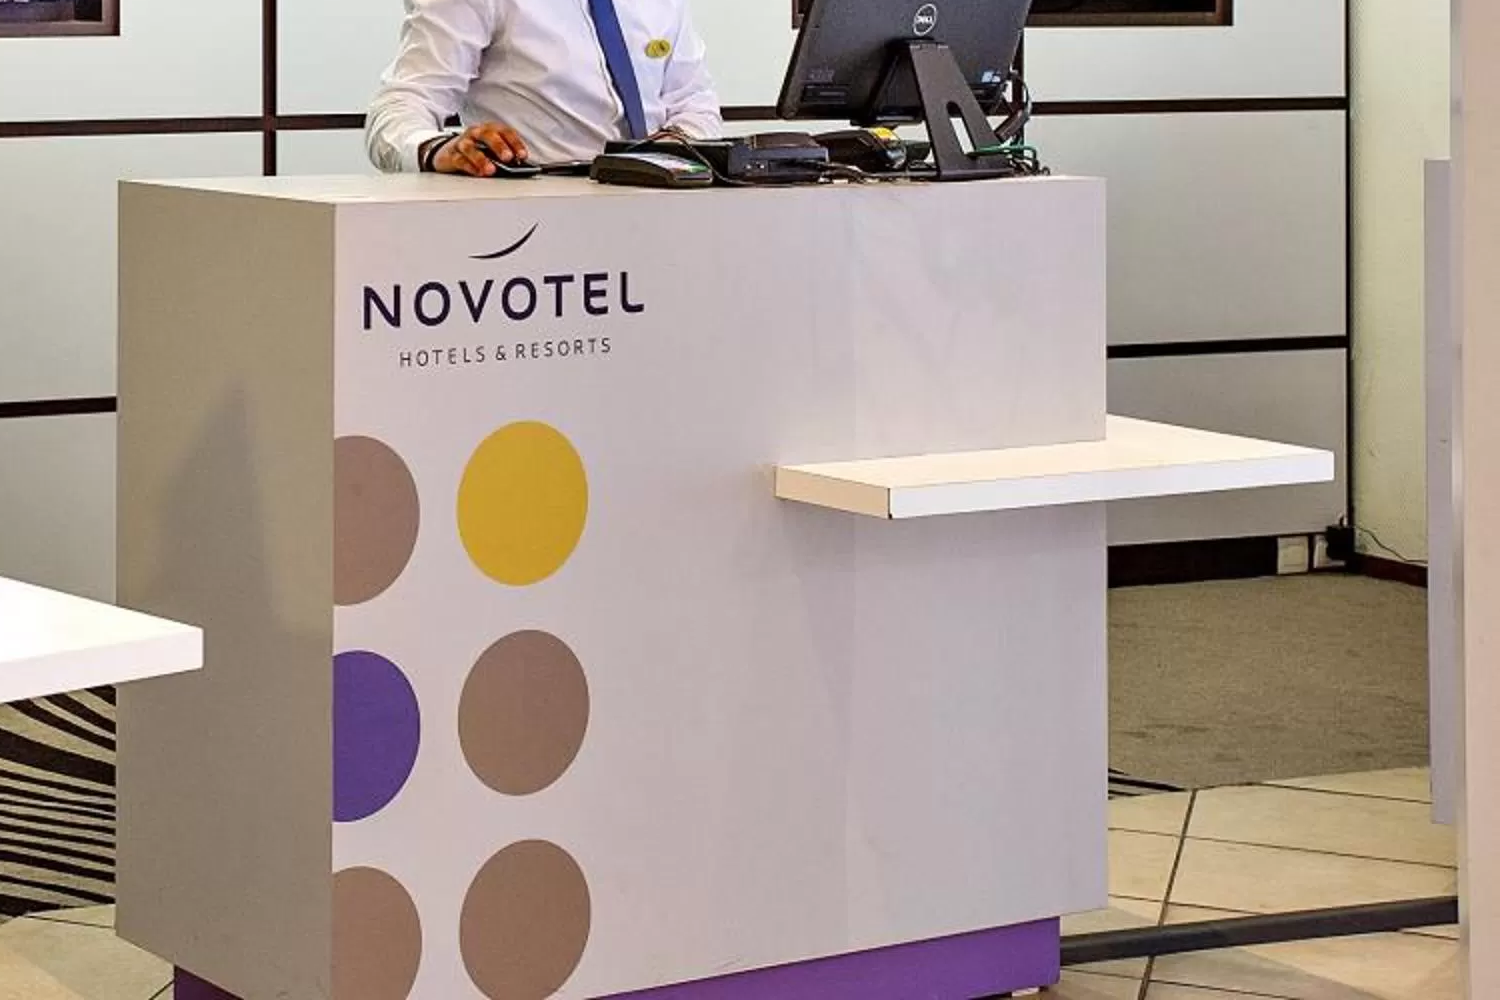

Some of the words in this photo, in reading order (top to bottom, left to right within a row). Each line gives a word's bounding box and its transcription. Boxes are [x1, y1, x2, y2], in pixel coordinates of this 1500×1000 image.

[363, 271, 645, 331] NOVOTEL
[400, 346, 486, 368] HOTELS
[495, 345, 507, 361] &
[515, 337, 612, 360] RESORTS
